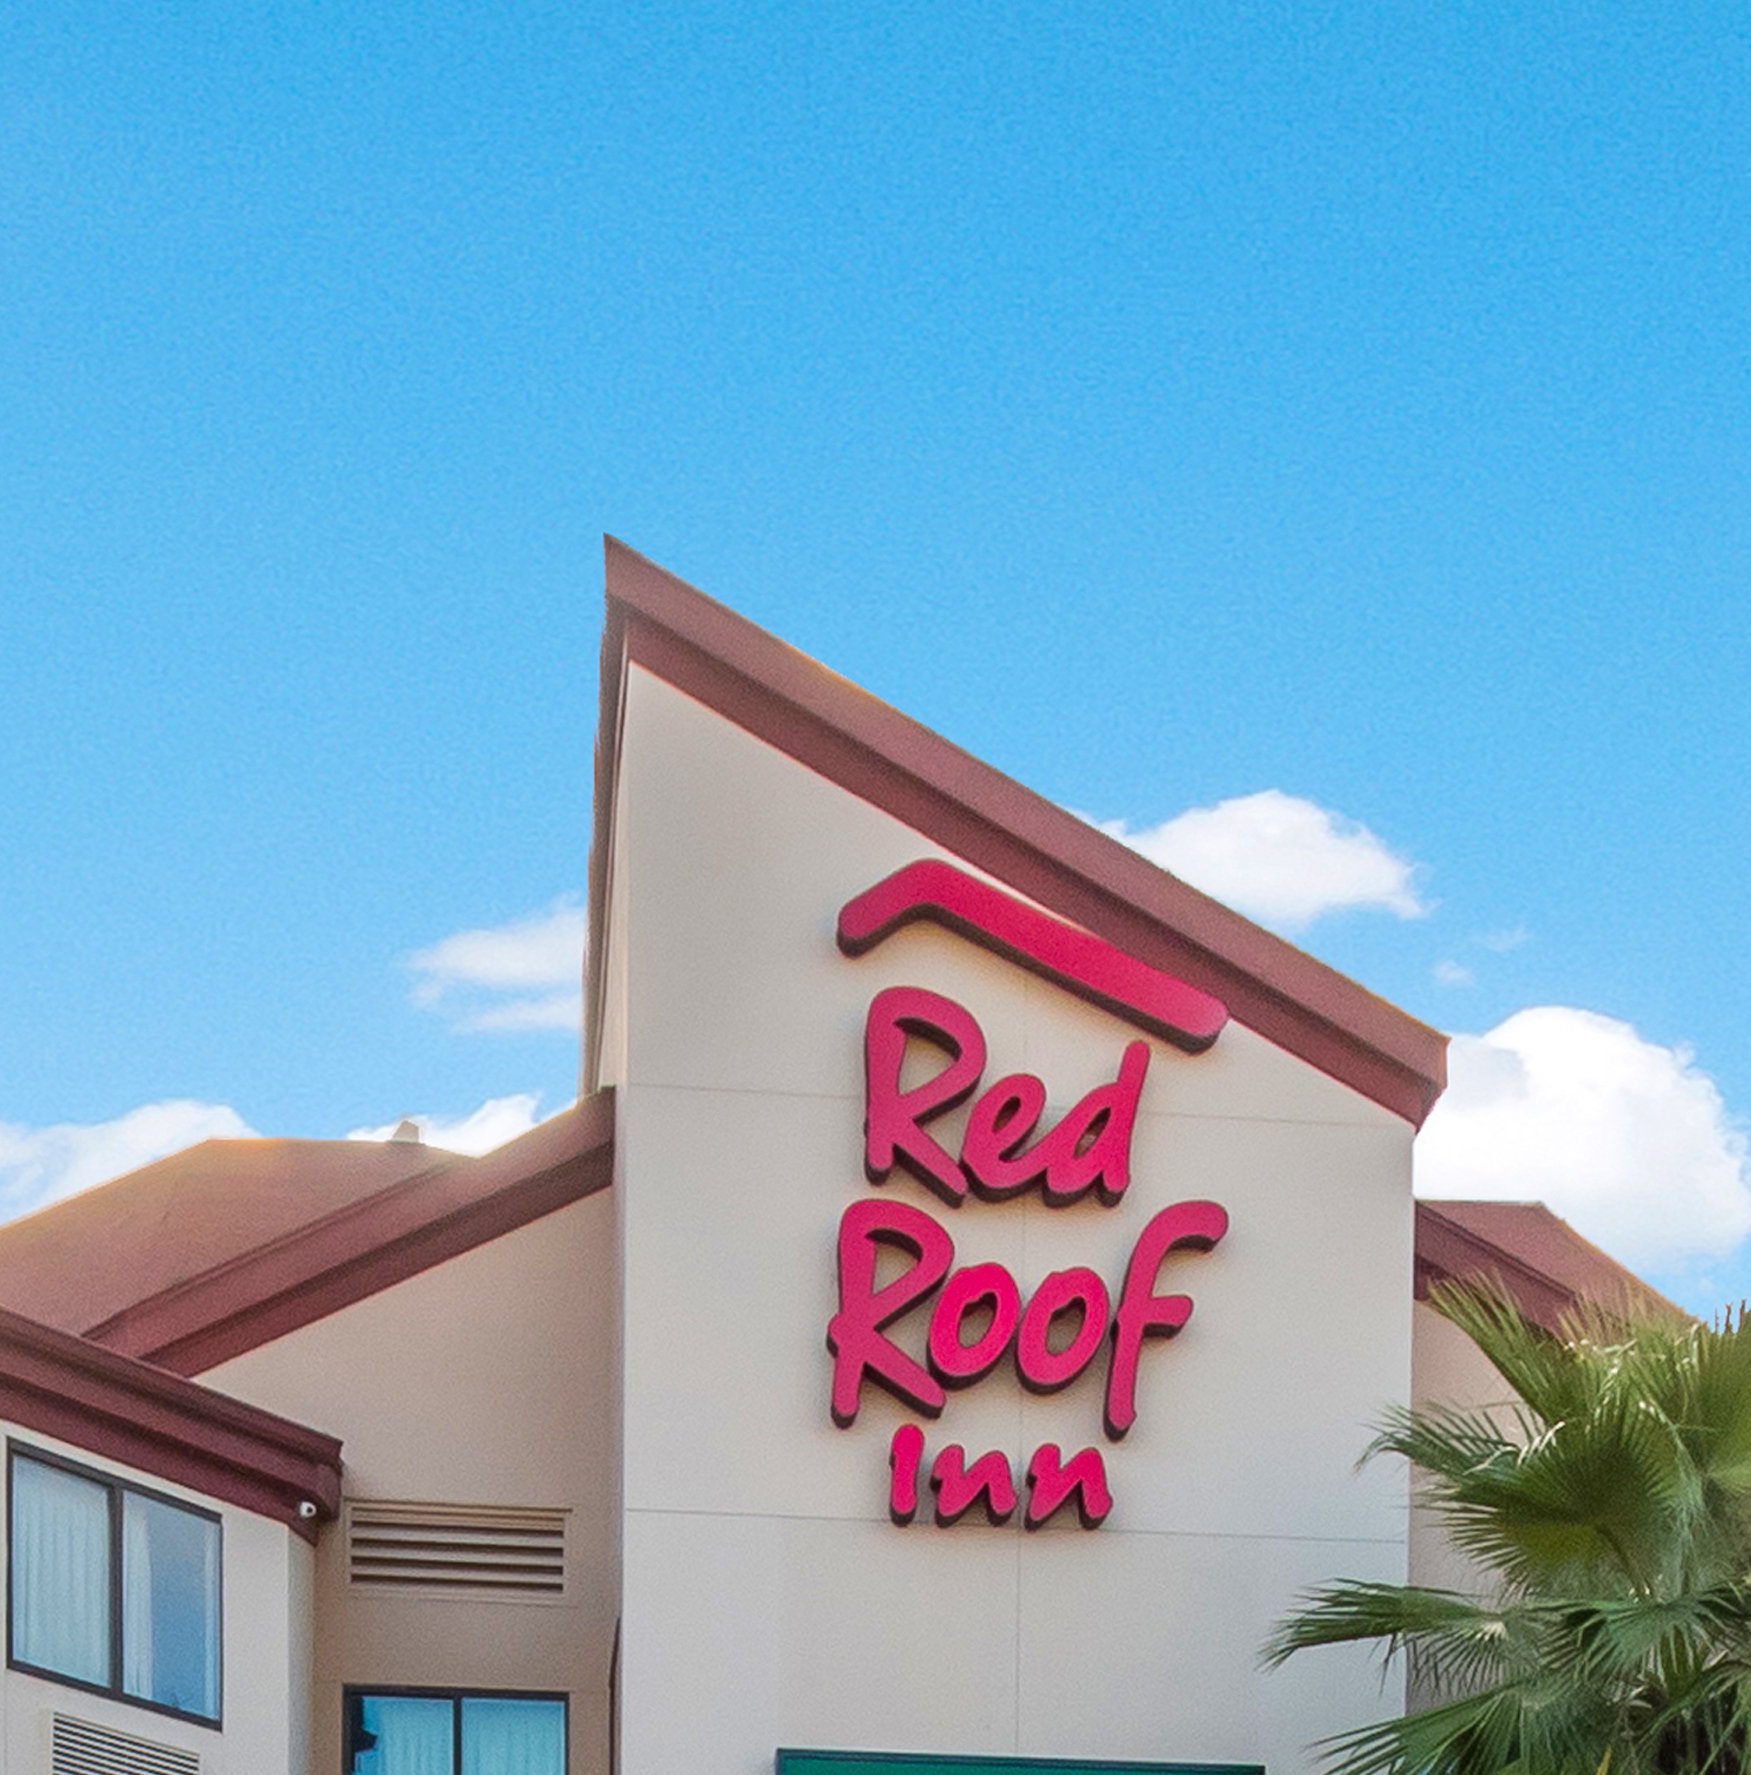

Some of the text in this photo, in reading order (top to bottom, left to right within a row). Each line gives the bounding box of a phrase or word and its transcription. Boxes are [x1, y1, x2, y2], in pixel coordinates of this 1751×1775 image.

[864, 986, 1151, 1208] Red
[826, 1198, 1230, 1442] Roof
[889, 1423, 1113, 1531] Inn
